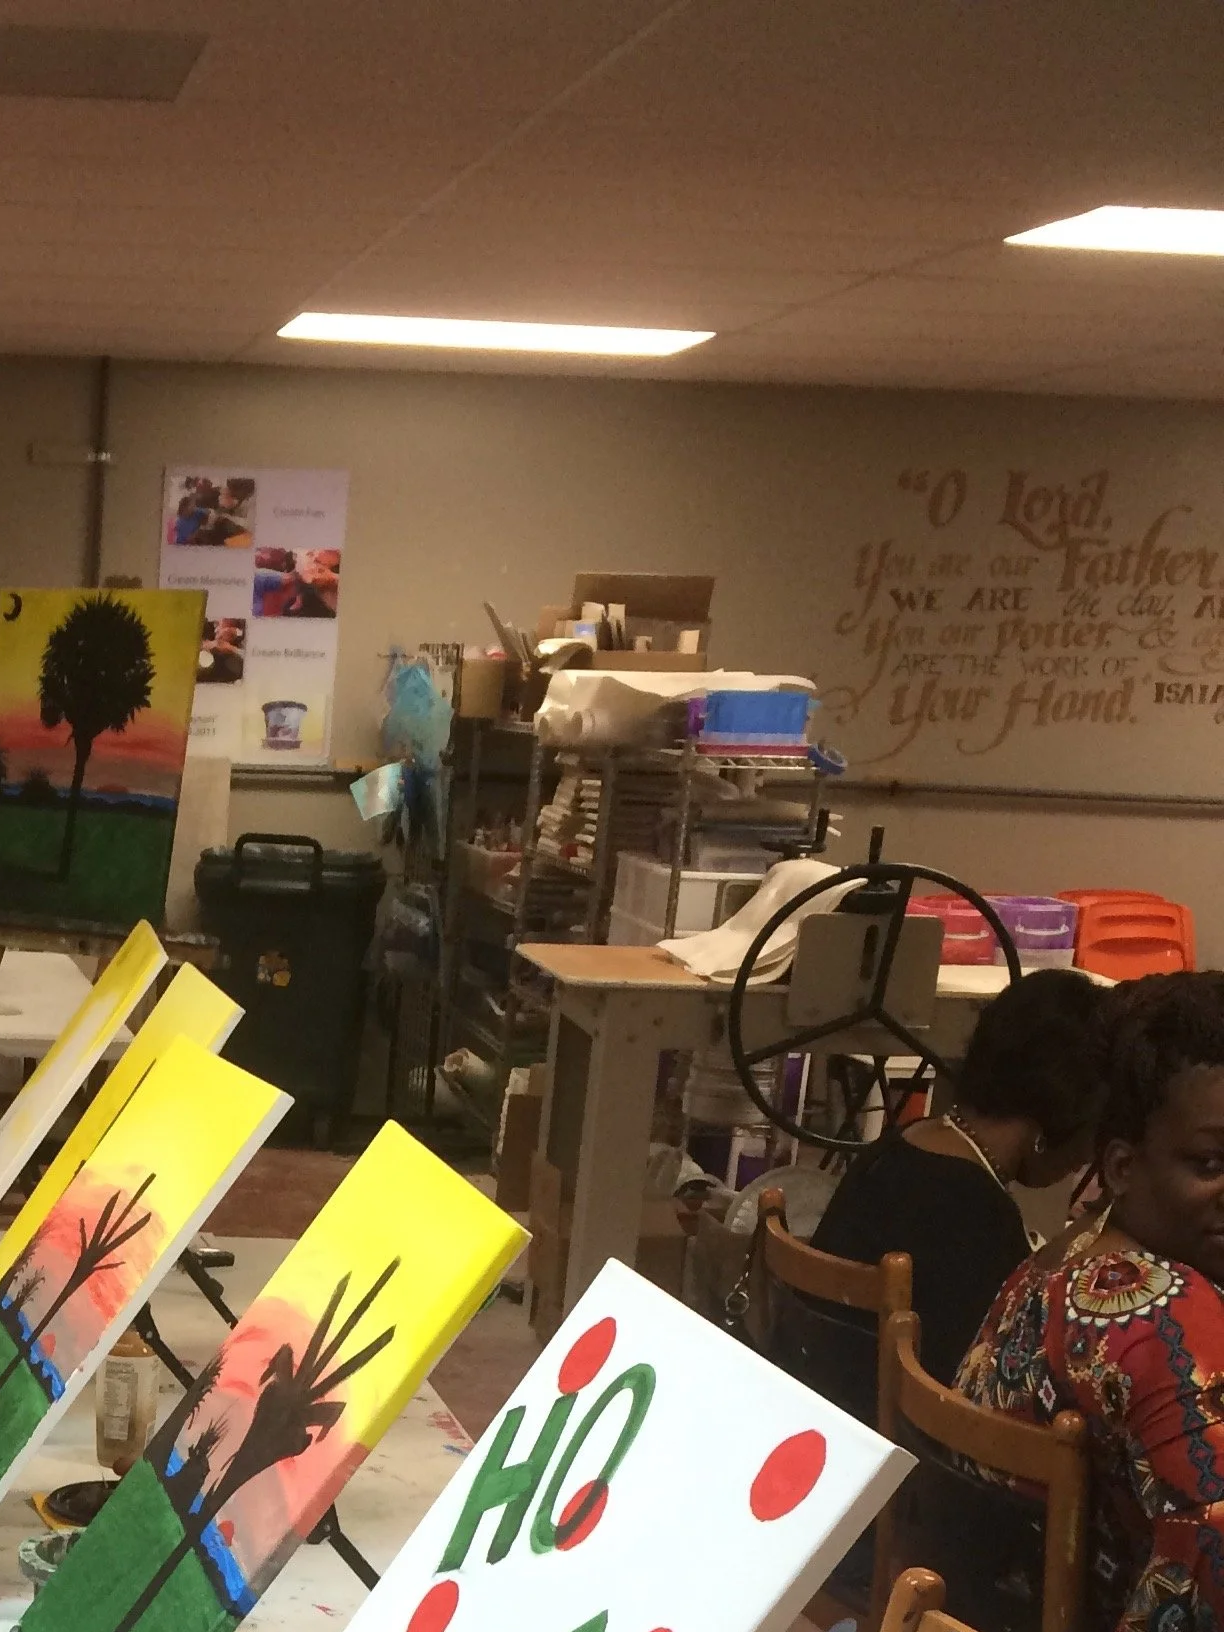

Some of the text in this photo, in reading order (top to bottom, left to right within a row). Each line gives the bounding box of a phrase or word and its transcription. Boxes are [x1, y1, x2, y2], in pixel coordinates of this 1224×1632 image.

[889, 587, 945, 612] WE
[961, 586, 1033, 612] ARE
[890, 653, 1139, 677] ARE THE WORK OF
[434, 1363, 657, 1574] HO
